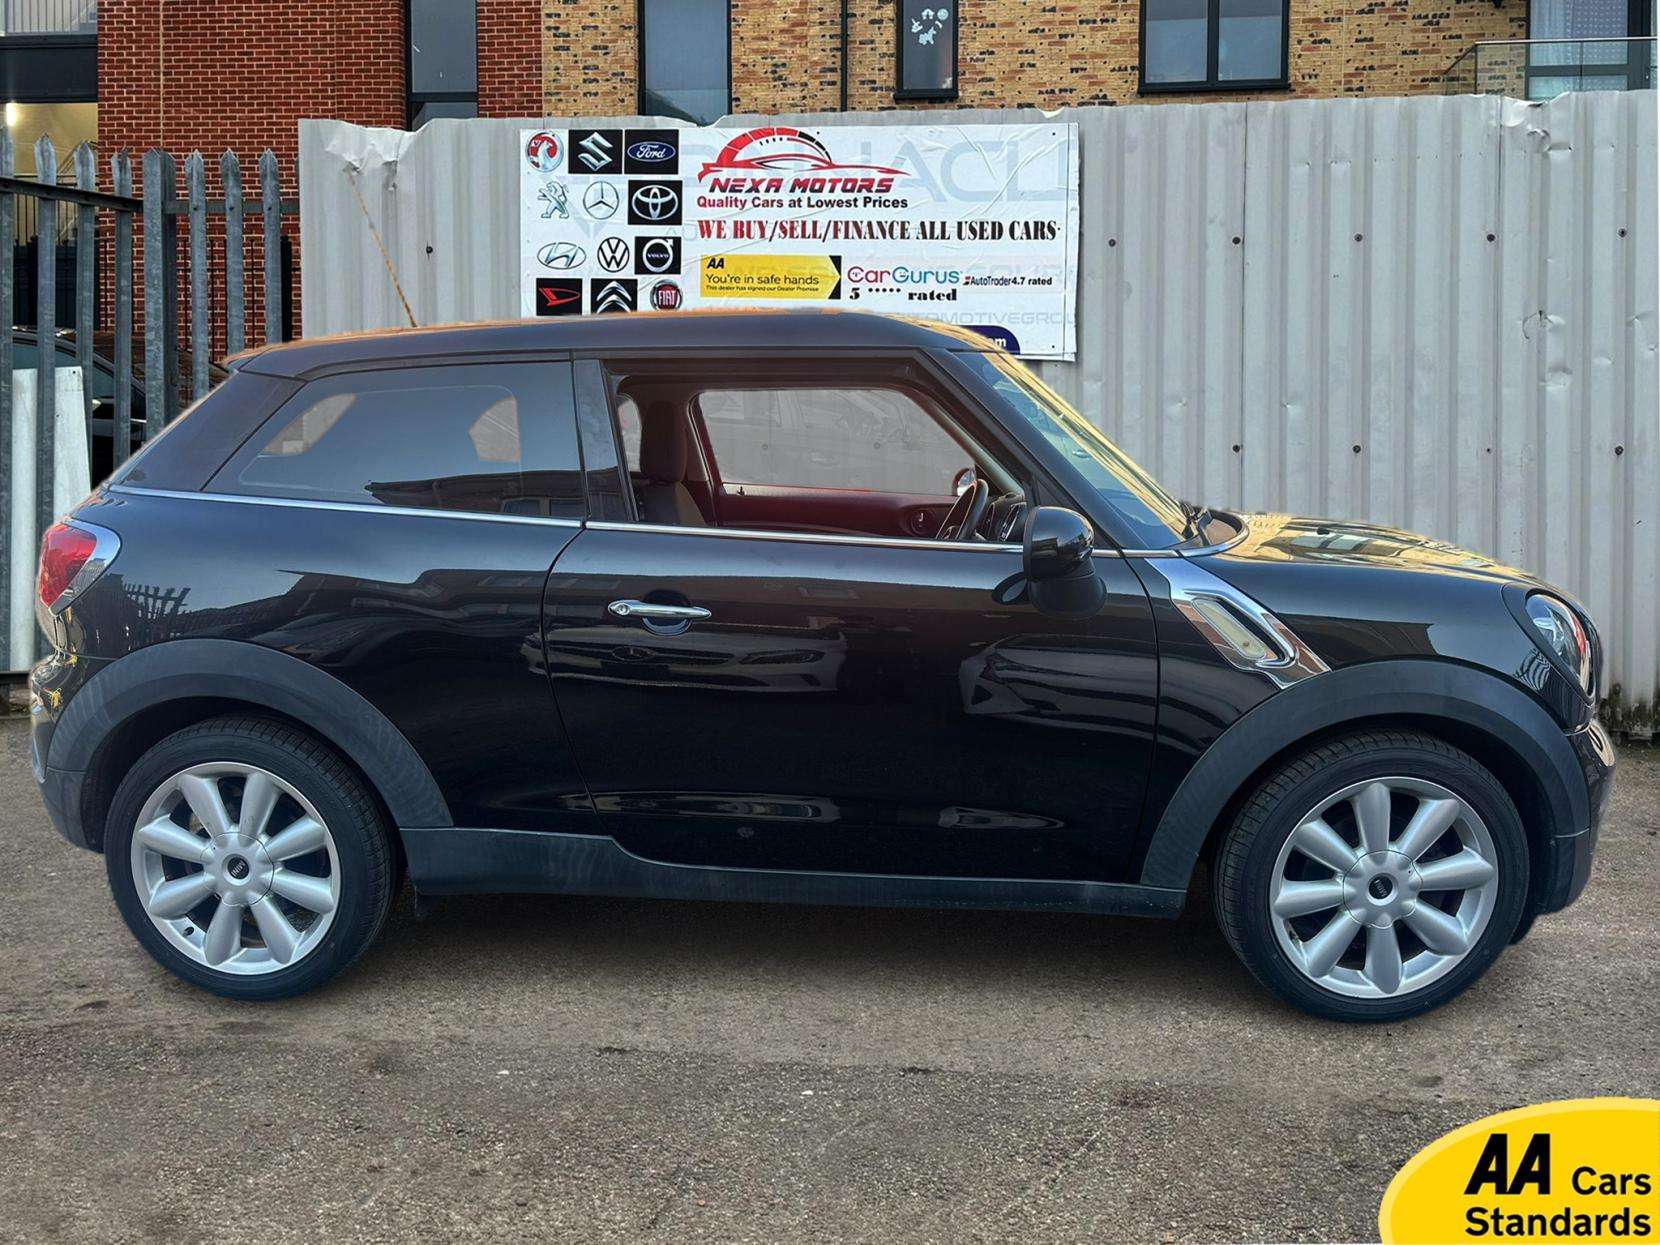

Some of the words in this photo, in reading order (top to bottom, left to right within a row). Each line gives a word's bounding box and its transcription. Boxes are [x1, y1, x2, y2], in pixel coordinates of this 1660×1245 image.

[636, 144, 666, 158] Ford
[709, 178, 783, 193] NEXA
[789, 178, 895, 193] MOTORS
[697, 196, 747, 210] Quality
[752, 196, 784, 208] Cars
[788, 196, 803, 208] at
[807, 196, 858, 208] Lowest
[863, 196, 908, 208] Prices
[697, 220, 727, 239] WE
[733, 220, 911, 242] BUY/SELL/FINANCE
[916, 220, 950, 240] ALL
[957, 220, 1004, 240] USED
[1009, 220, 1057, 240] CARS
[707, 258, 724, 269] AA
[706, 274, 741, 284] You're
[744, 274, 754, 284] in
[757, 274, 781, 285] safe
[784, 275, 820, 285] hands
[847, 266, 960, 284] CarGurus
[1028, 277, 1053, 285] rated
[658, 290, 676, 305] FIAT
[850, 288, 860, 300] 5
[908, 289, 957, 301] rated
